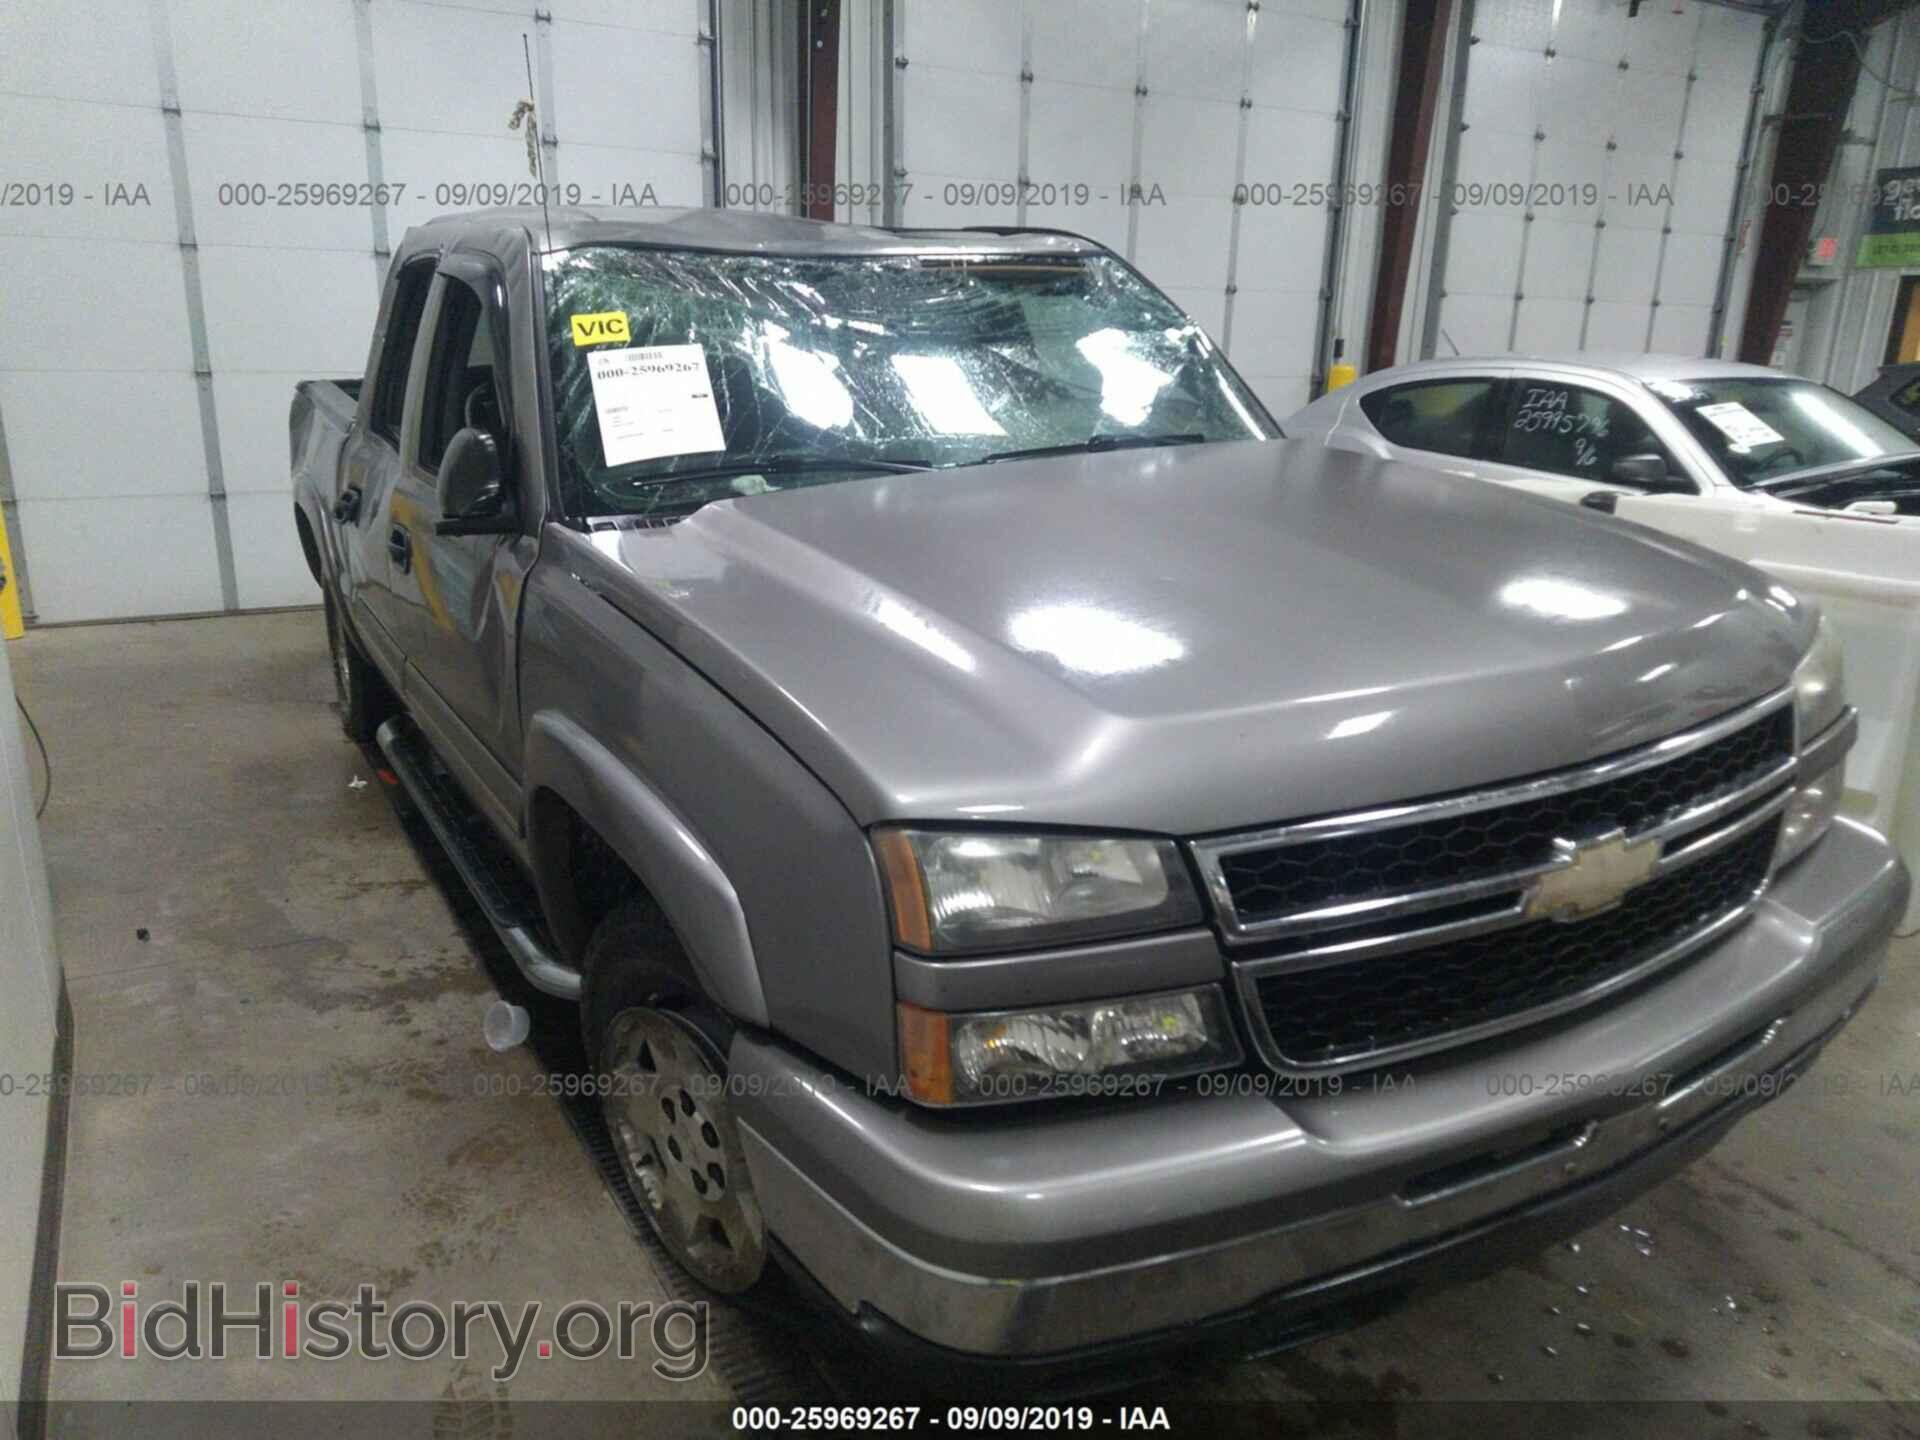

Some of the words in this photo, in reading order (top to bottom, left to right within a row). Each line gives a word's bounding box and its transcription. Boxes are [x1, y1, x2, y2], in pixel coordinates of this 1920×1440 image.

[577, 318, 624, 337] VIC
[597, 361, 700, 381] 000-25969267
[1522, 388, 1568, 410] IAA
